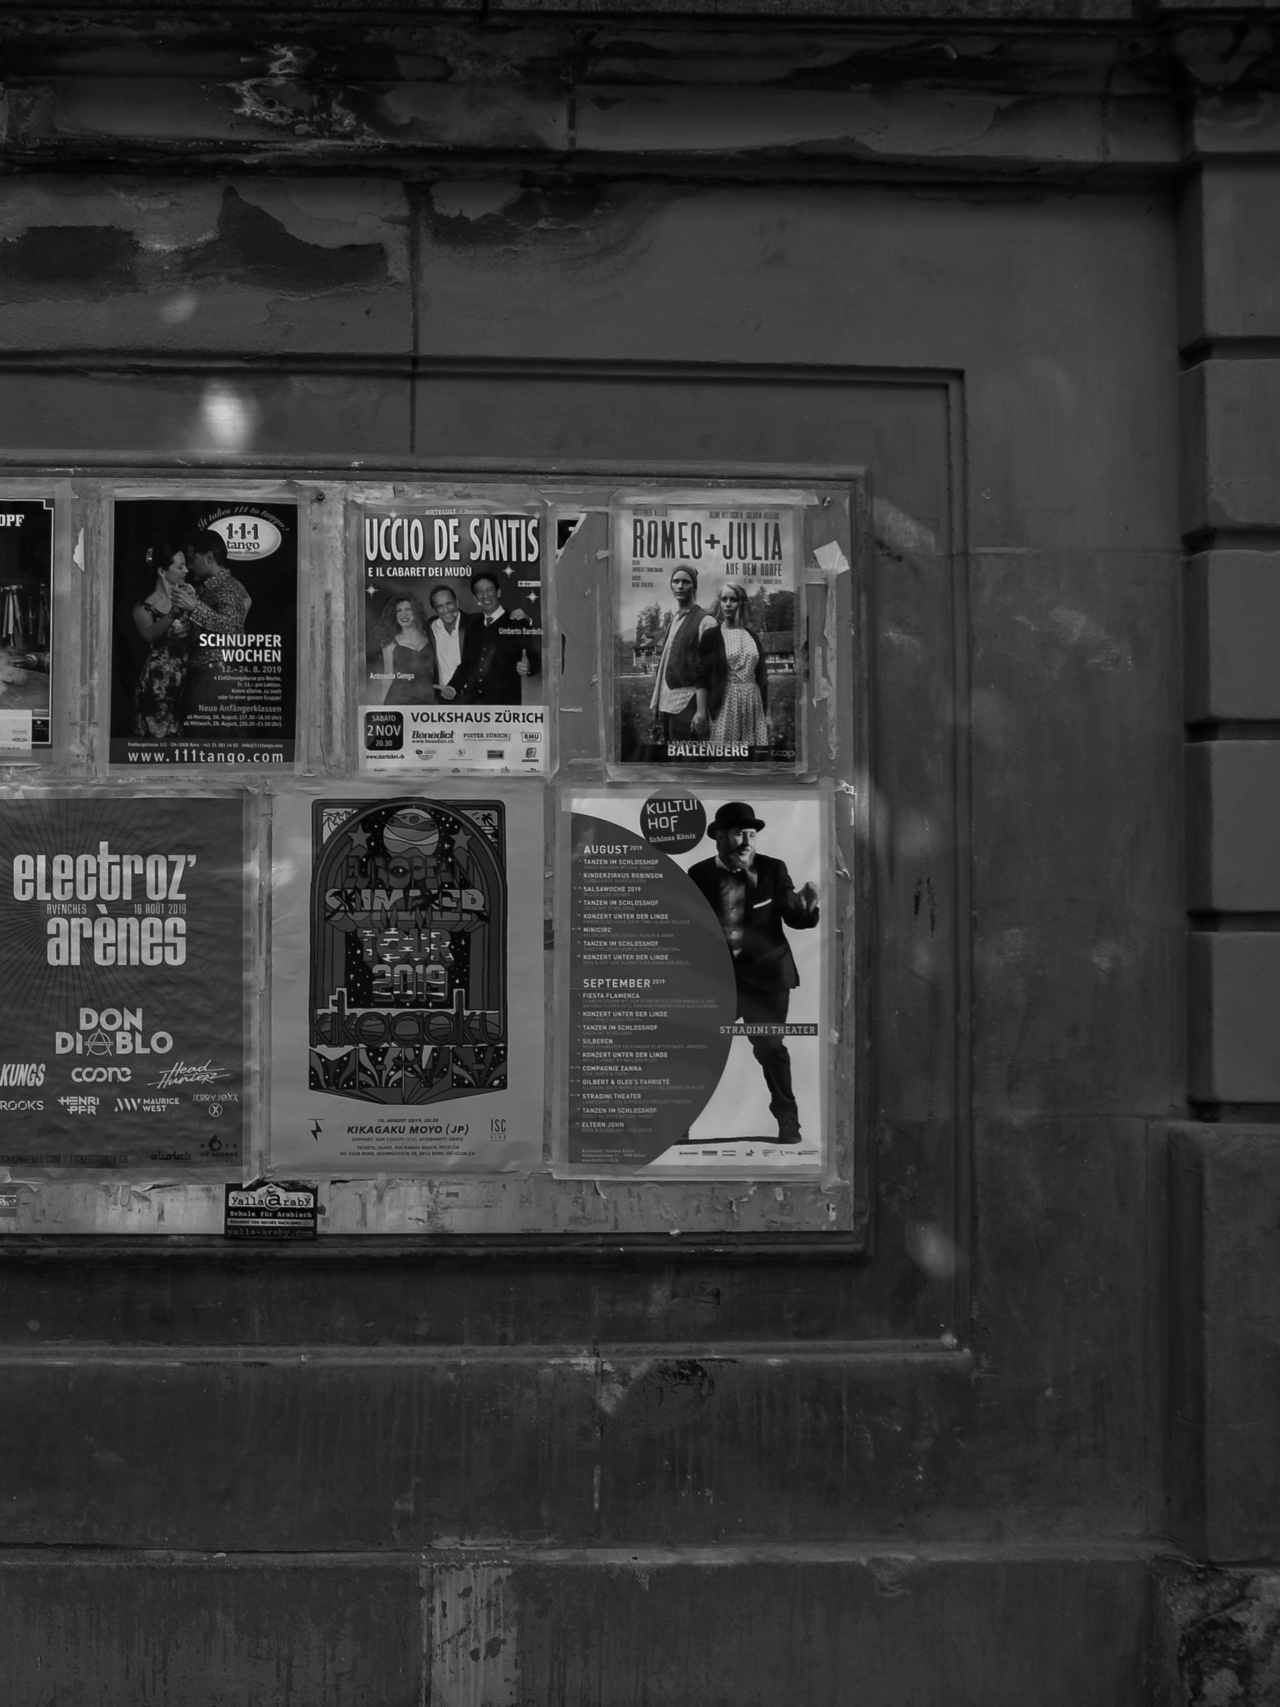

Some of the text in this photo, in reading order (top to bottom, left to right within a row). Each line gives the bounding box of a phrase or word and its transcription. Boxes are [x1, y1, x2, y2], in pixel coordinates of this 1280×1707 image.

[227, 540, 260, 551] tango
[366, 518, 538, 562] UCCIO DE SANTIS
[368, 568, 373, 577] E
[376, 568, 385, 577] IL
[387, 567, 426, 577] CABARET
[429, 567, 442, 577] DEI
[726, 563, 782, 576] AUF DEM DORFE
[199, 634, 282, 647] SCHNUPPER
[222, 649, 282, 662] WOCHEN
[220, 704, 282, 713] Anfängerklassen
[411, 710, 543, 723] VOLKSHAUS ZÜRICH
[367, 725, 401, 736] 2 NOV
[128, 749, 284, 764] www.111tango.com
[667, 745, 749, 757] BALLENBERG
[648, 815, 678, 832] HOF
[649, 834, 675, 843] Schloss
[584, 845, 628, 854] AUGUST
[47, 902, 186, 914] AVENCHES 16 AOÛT 2019
[47, 904, 186, 966] arènes
[583, 978, 651, 989] SEPTEMBER
[80, 1007, 142, 1031] DON
[720, 1026, 816, 1034] STRADINI THEATER
[55, 1029, 173, 1056] DIABLO
[0, 1063, 46, 1087] KUNGS
[347, 1124, 469, 1135] KIKAGAKU MOYO (JP)
[491, 1119, 506, 1132] ISC
[227, 1228, 313, 1238] yalla-araby.com
